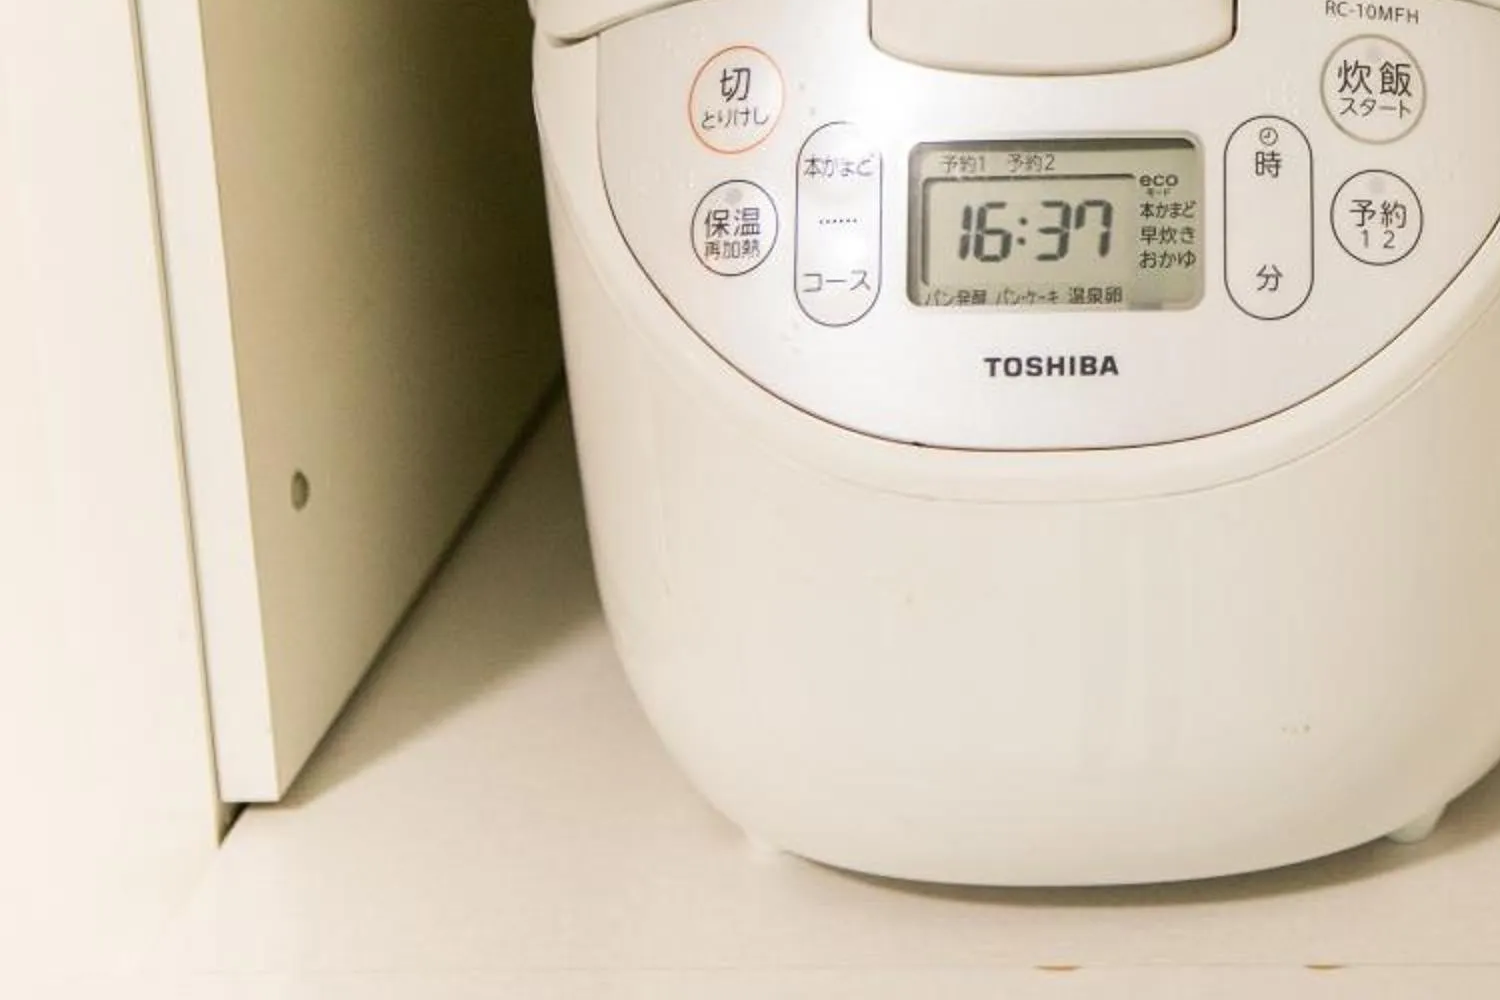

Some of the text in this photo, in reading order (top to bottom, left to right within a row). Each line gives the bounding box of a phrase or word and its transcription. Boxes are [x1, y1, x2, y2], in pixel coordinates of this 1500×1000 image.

[1324, 0, 1420, 24] RC-10MFH
[719, 67, 751, 102] 切
[1337, 60, 1412, 98] 炊飯
[701, 107, 770, 130] とりけし
[1339, 97, 1411, 119] スタート
[803, 153, 875, 178] 本かまど
[1255, 150, 1283, 178] 時
[1138, 174, 1179, 187] eco
[1139, 201, 1197, 220] 本かまど
[1349, 200, 1407, 230] 予約
[704, 208, 761, 238] 保温
[958, 199, 1113, 263] 16:37
[1139, 227, 1197, 246] 早炊き
[703, 239, 761, 259] 再加熱
[1138, 250, 1197, 269] おかゆ
[802, 270, 871, 293] コース
[1256, 264, 1283, 292] 分
[984, 355, 1120, 377] TOSHIBA
